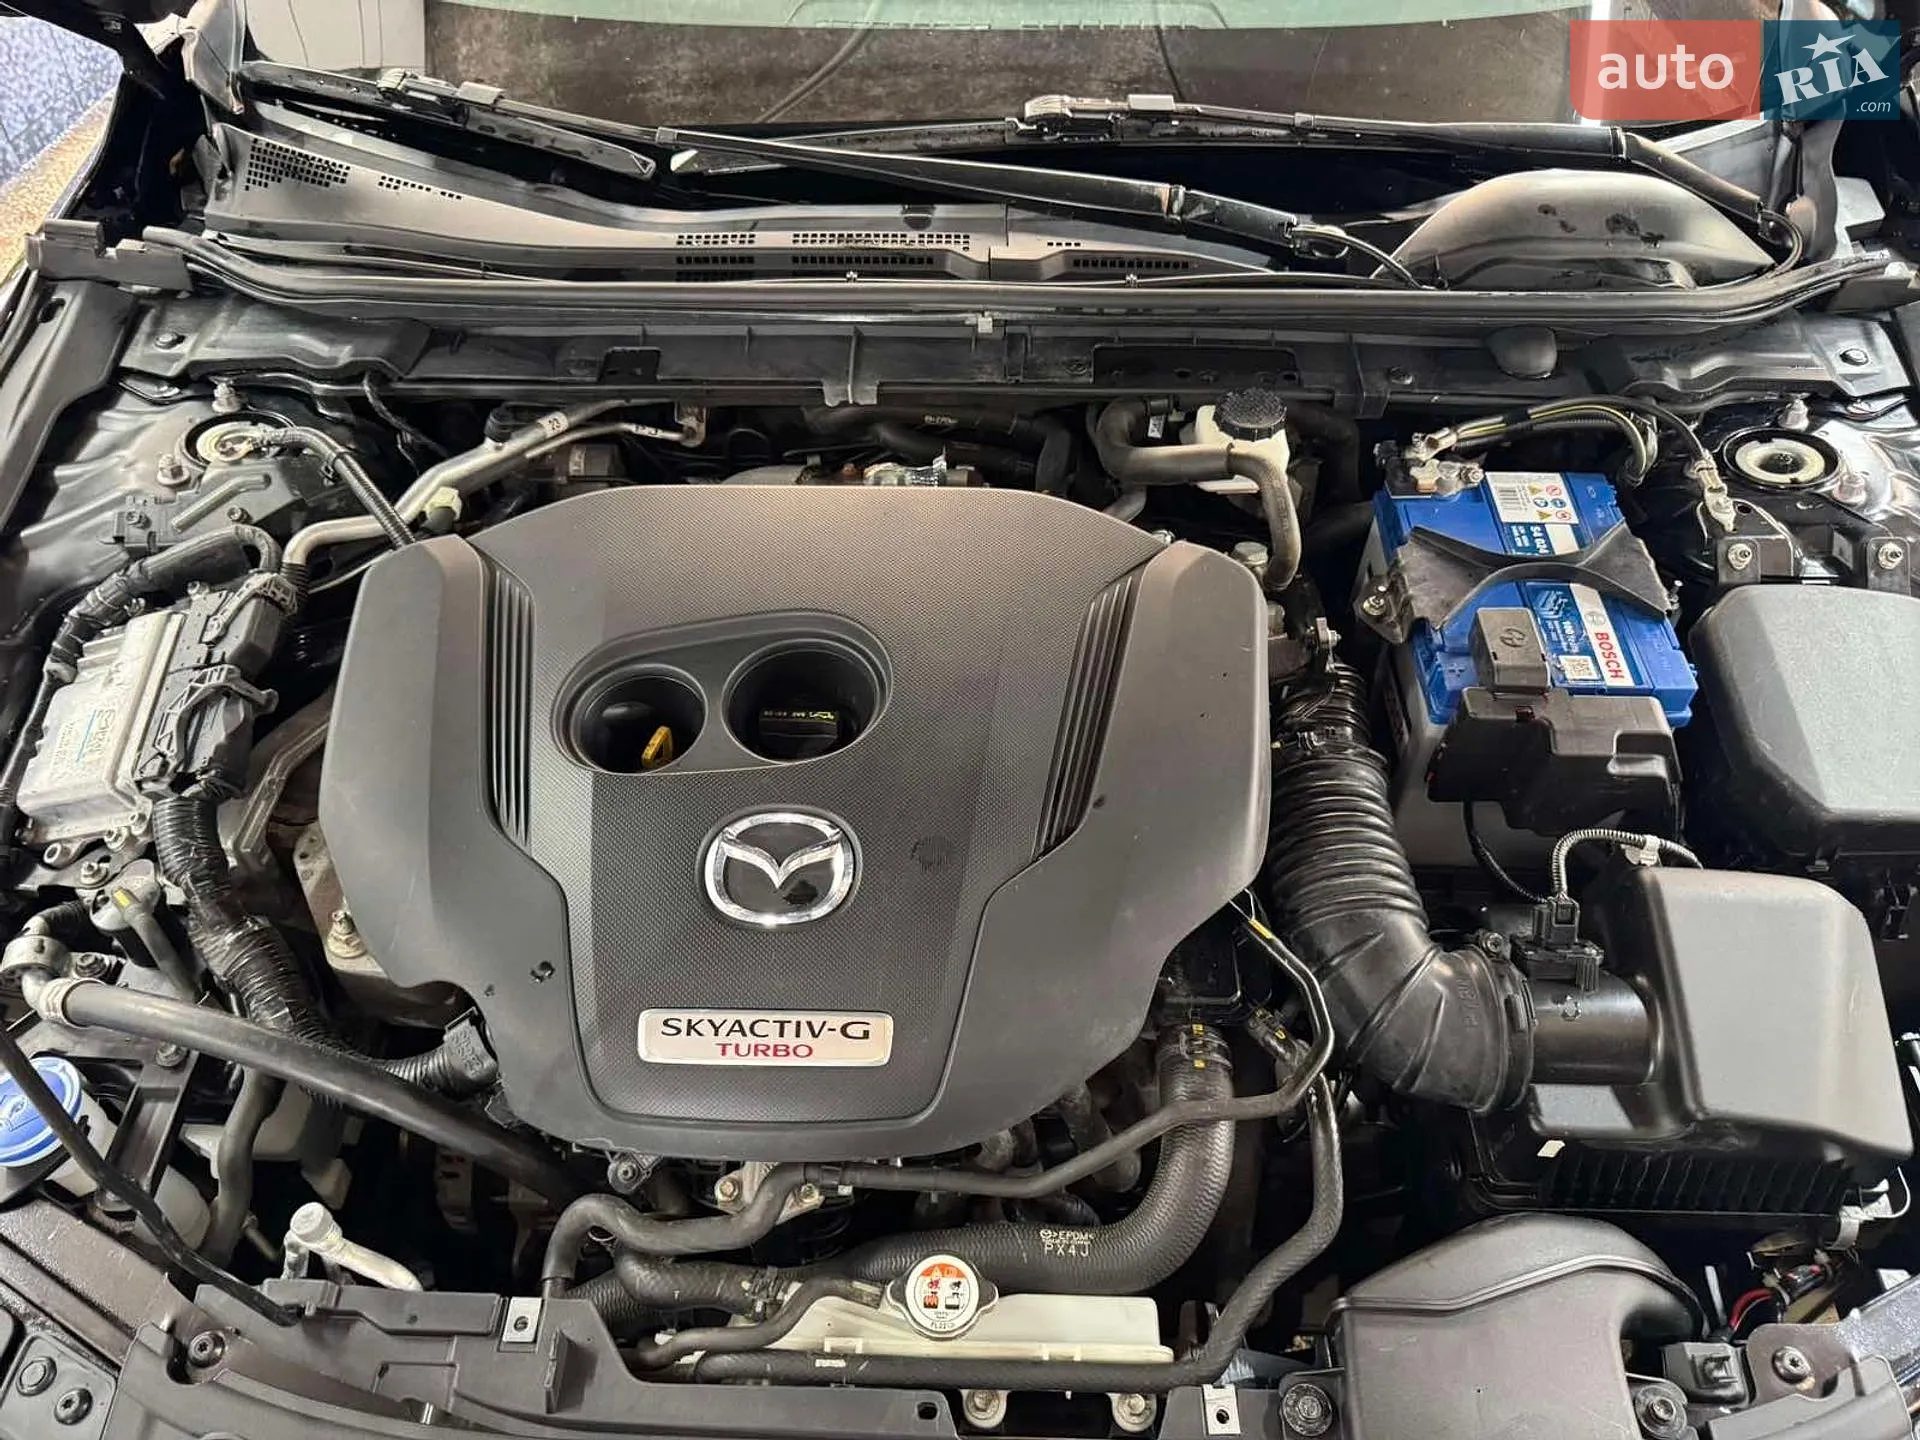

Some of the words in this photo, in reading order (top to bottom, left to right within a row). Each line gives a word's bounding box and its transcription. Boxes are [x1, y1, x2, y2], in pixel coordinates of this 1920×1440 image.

[1594, 631, 1625, 680] BOSCH
[661, 1017, 870, 1040] SKYACTIV-G
[716, 1043, 814, 1058] TURBO
